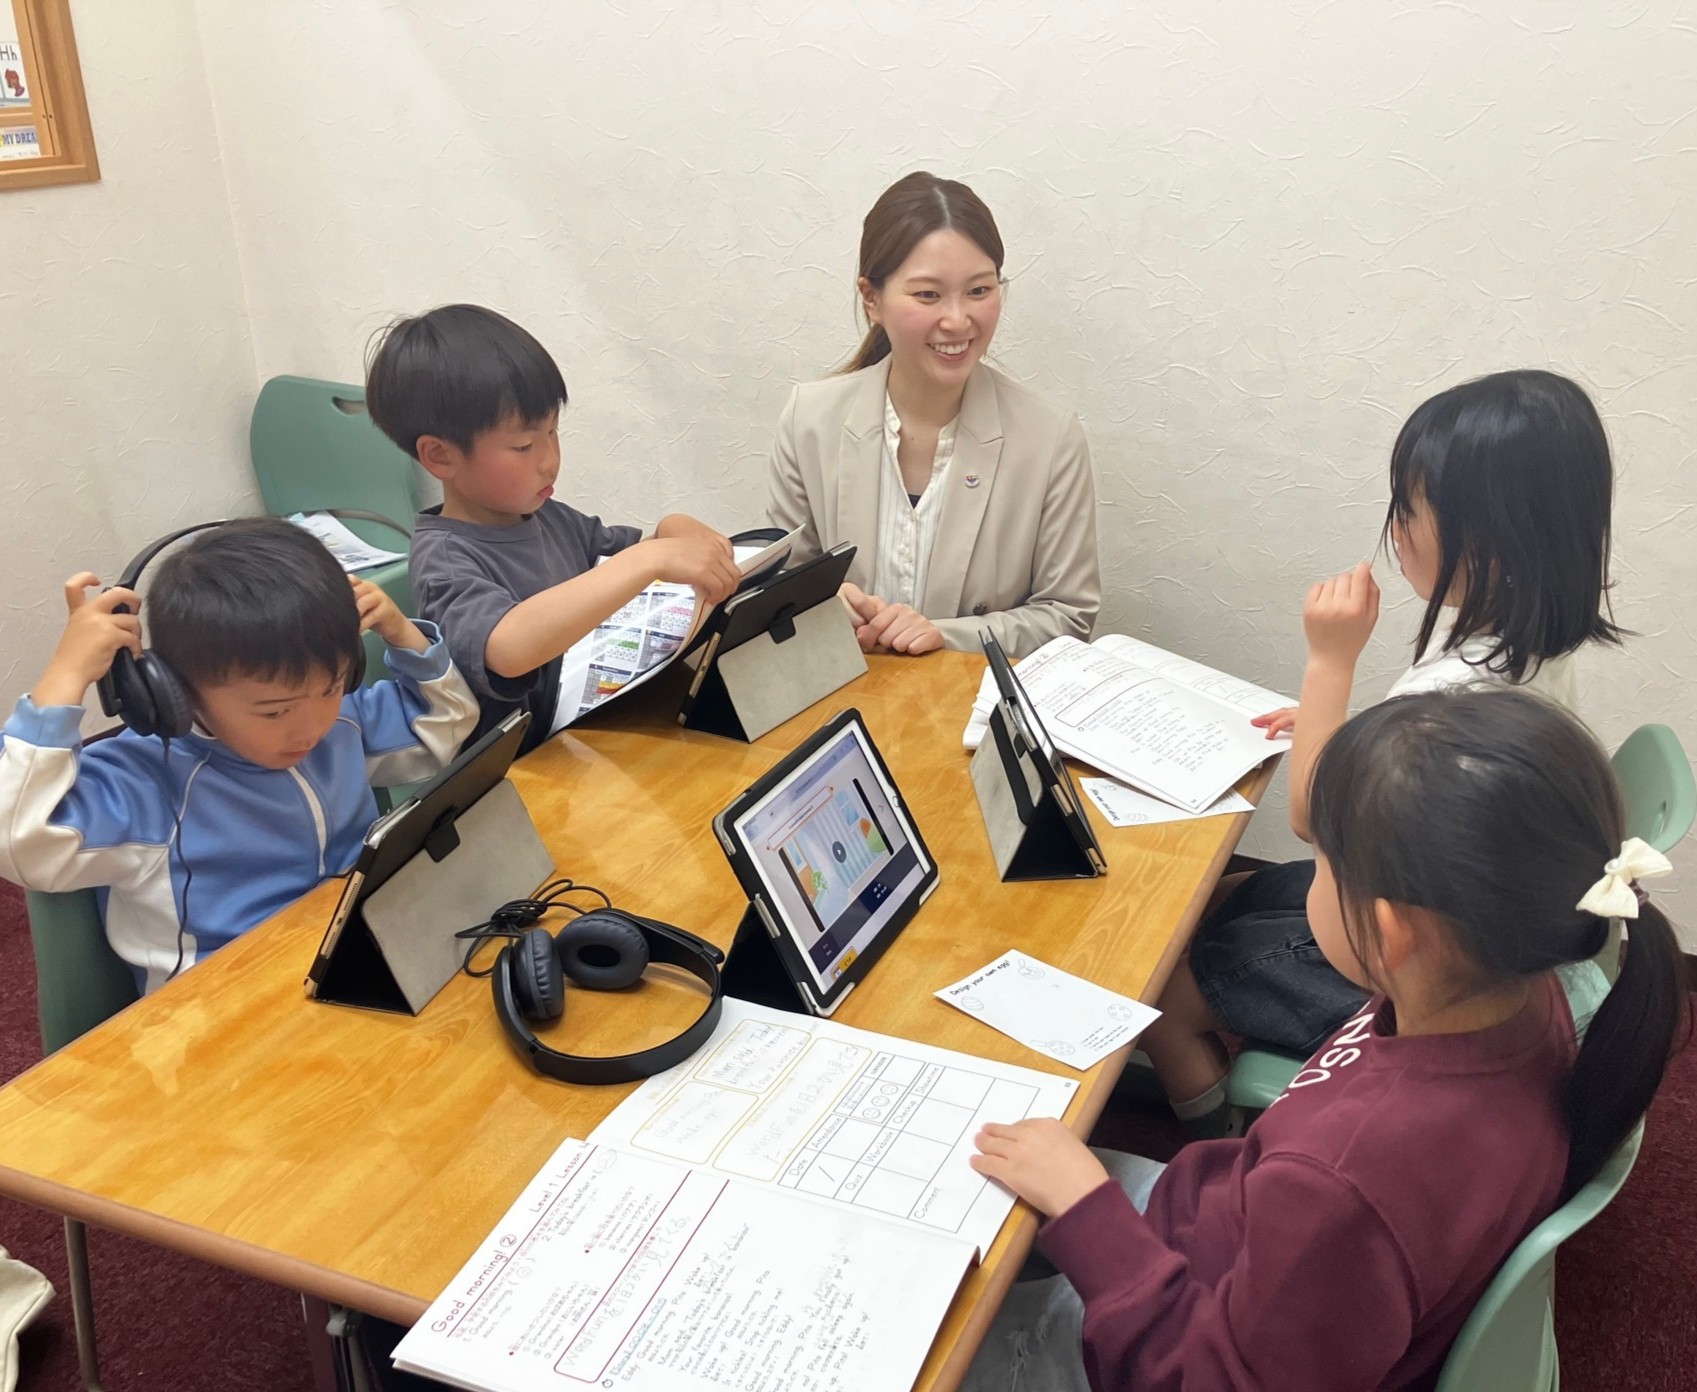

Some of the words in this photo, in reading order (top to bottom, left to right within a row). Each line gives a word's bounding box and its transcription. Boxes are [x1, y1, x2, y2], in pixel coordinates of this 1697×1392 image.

[15, 132, 38, 144] DREA
[948, 984, 970, 995] Design
[971, 975, 983, 985] your
[984, 968, 996, 976] own
[844, 1174, 863, 1190] Quiz
[865, 1131, 892, 1161] Workbook
[892, 1100, 916, 1123] Checkup
[914, 1067, 939, 1093] Showtime
[787, 1159, 808, 1176] Date
[811, 1117, 841, 1150] Attendance
[565, 1181, 590, 1209] breakfast
[913, 1186, 940, 1219] Comment
[430, 1299, 465, 1332] Good
[465, 1249, 508, 1298] morning!
[528, 1190, 552, 1212] Level
[554, 1152, 582, 1178] Lesson
[468, 1315, 488, 1335] Good
[724, 1318, 741, 1337] Good
[636, 1339, 654, 1358] Good
[677, 1355, 692, 1371] Your
